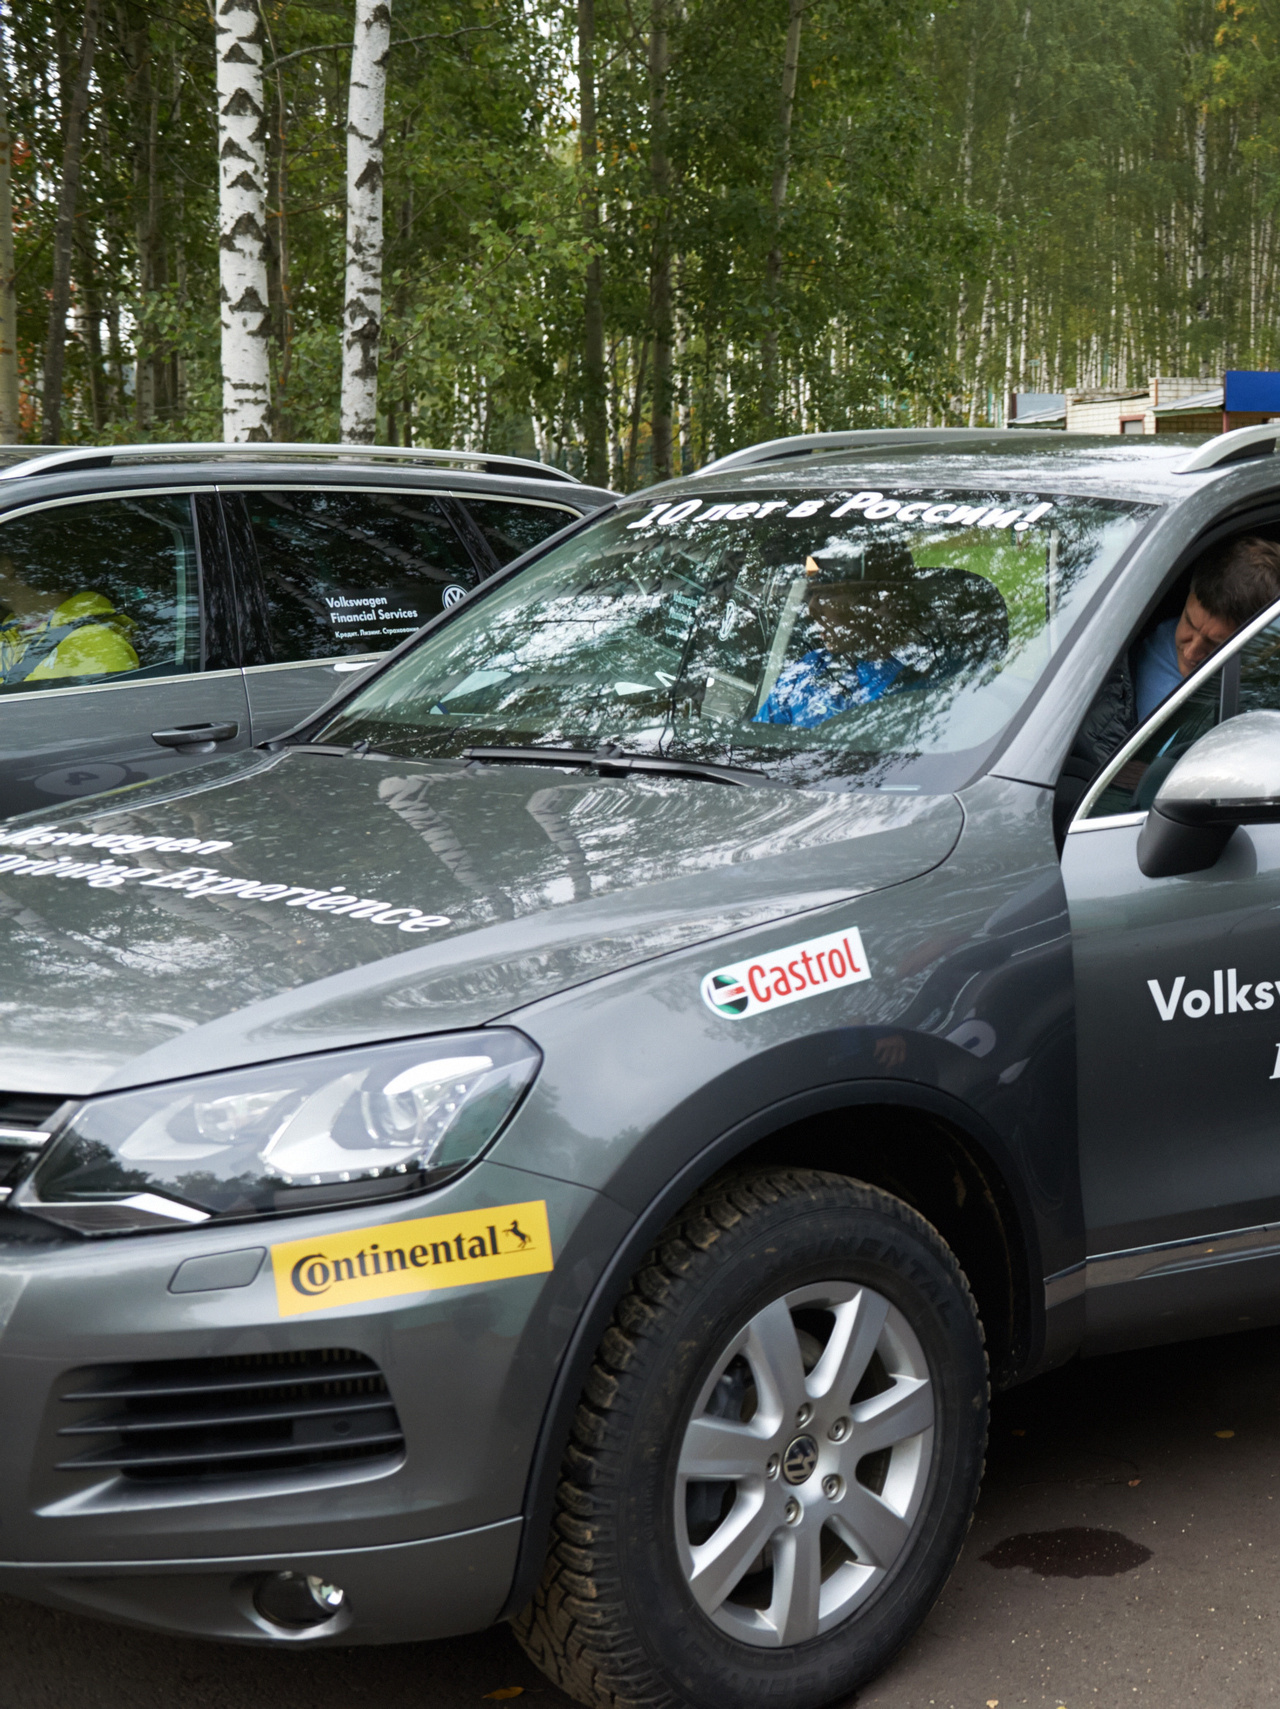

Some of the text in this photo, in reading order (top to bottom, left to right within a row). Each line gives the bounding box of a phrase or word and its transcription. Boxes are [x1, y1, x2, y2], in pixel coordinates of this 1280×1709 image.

[626, 491, 1053, 531] 10 лет в России!
[326, 596, 387, 609] Volkswagen
[330, 608, 418, 623] Financial Services
[0, 826, 233, 855] lkswagen
[139, 866, 450, 933] Experience
[748, 938, 861, 1003] Castrol
[291, 1225, 501, 1297] Continental
